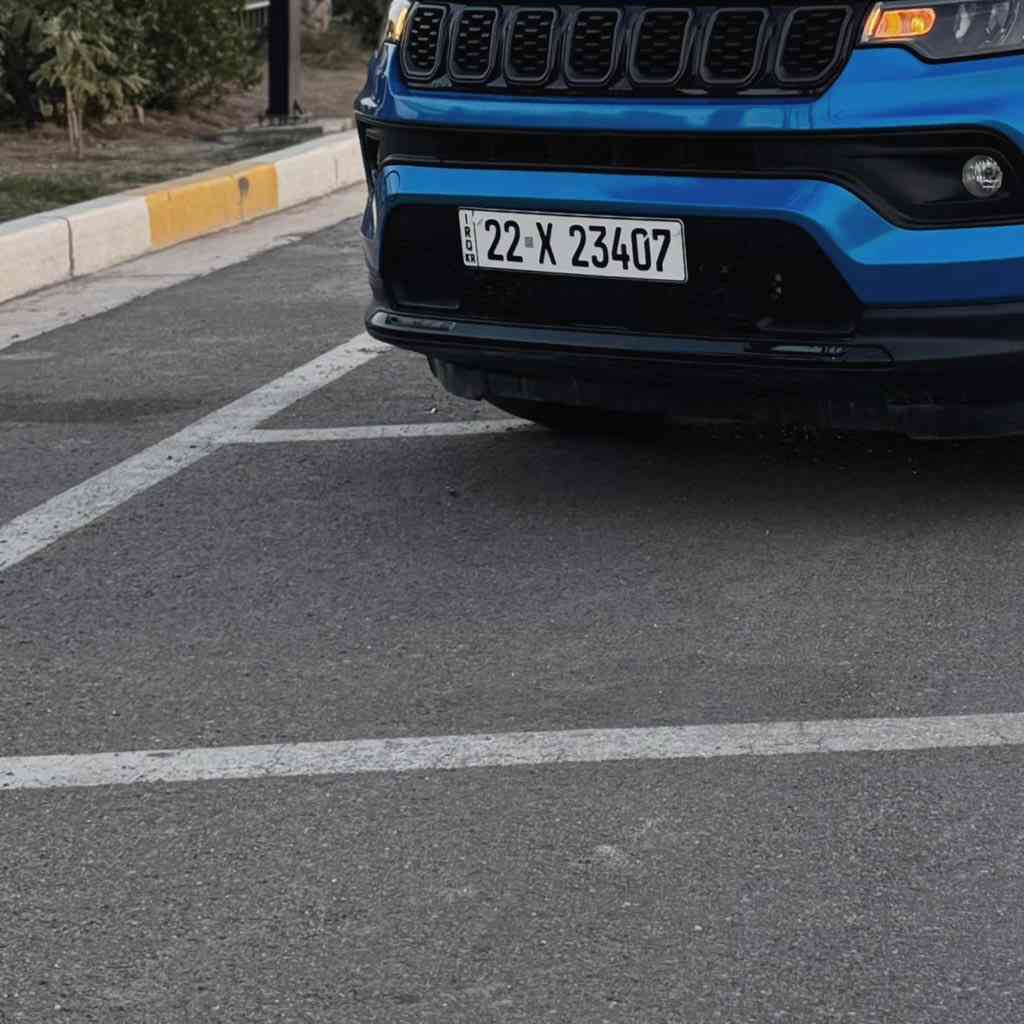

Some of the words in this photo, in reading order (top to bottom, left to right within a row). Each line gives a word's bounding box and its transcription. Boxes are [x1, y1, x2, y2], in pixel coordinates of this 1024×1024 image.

[485, 219, 523, 263] 22
[536, 222, 556, 265] X
[569, 225, 671, 272] 23407
